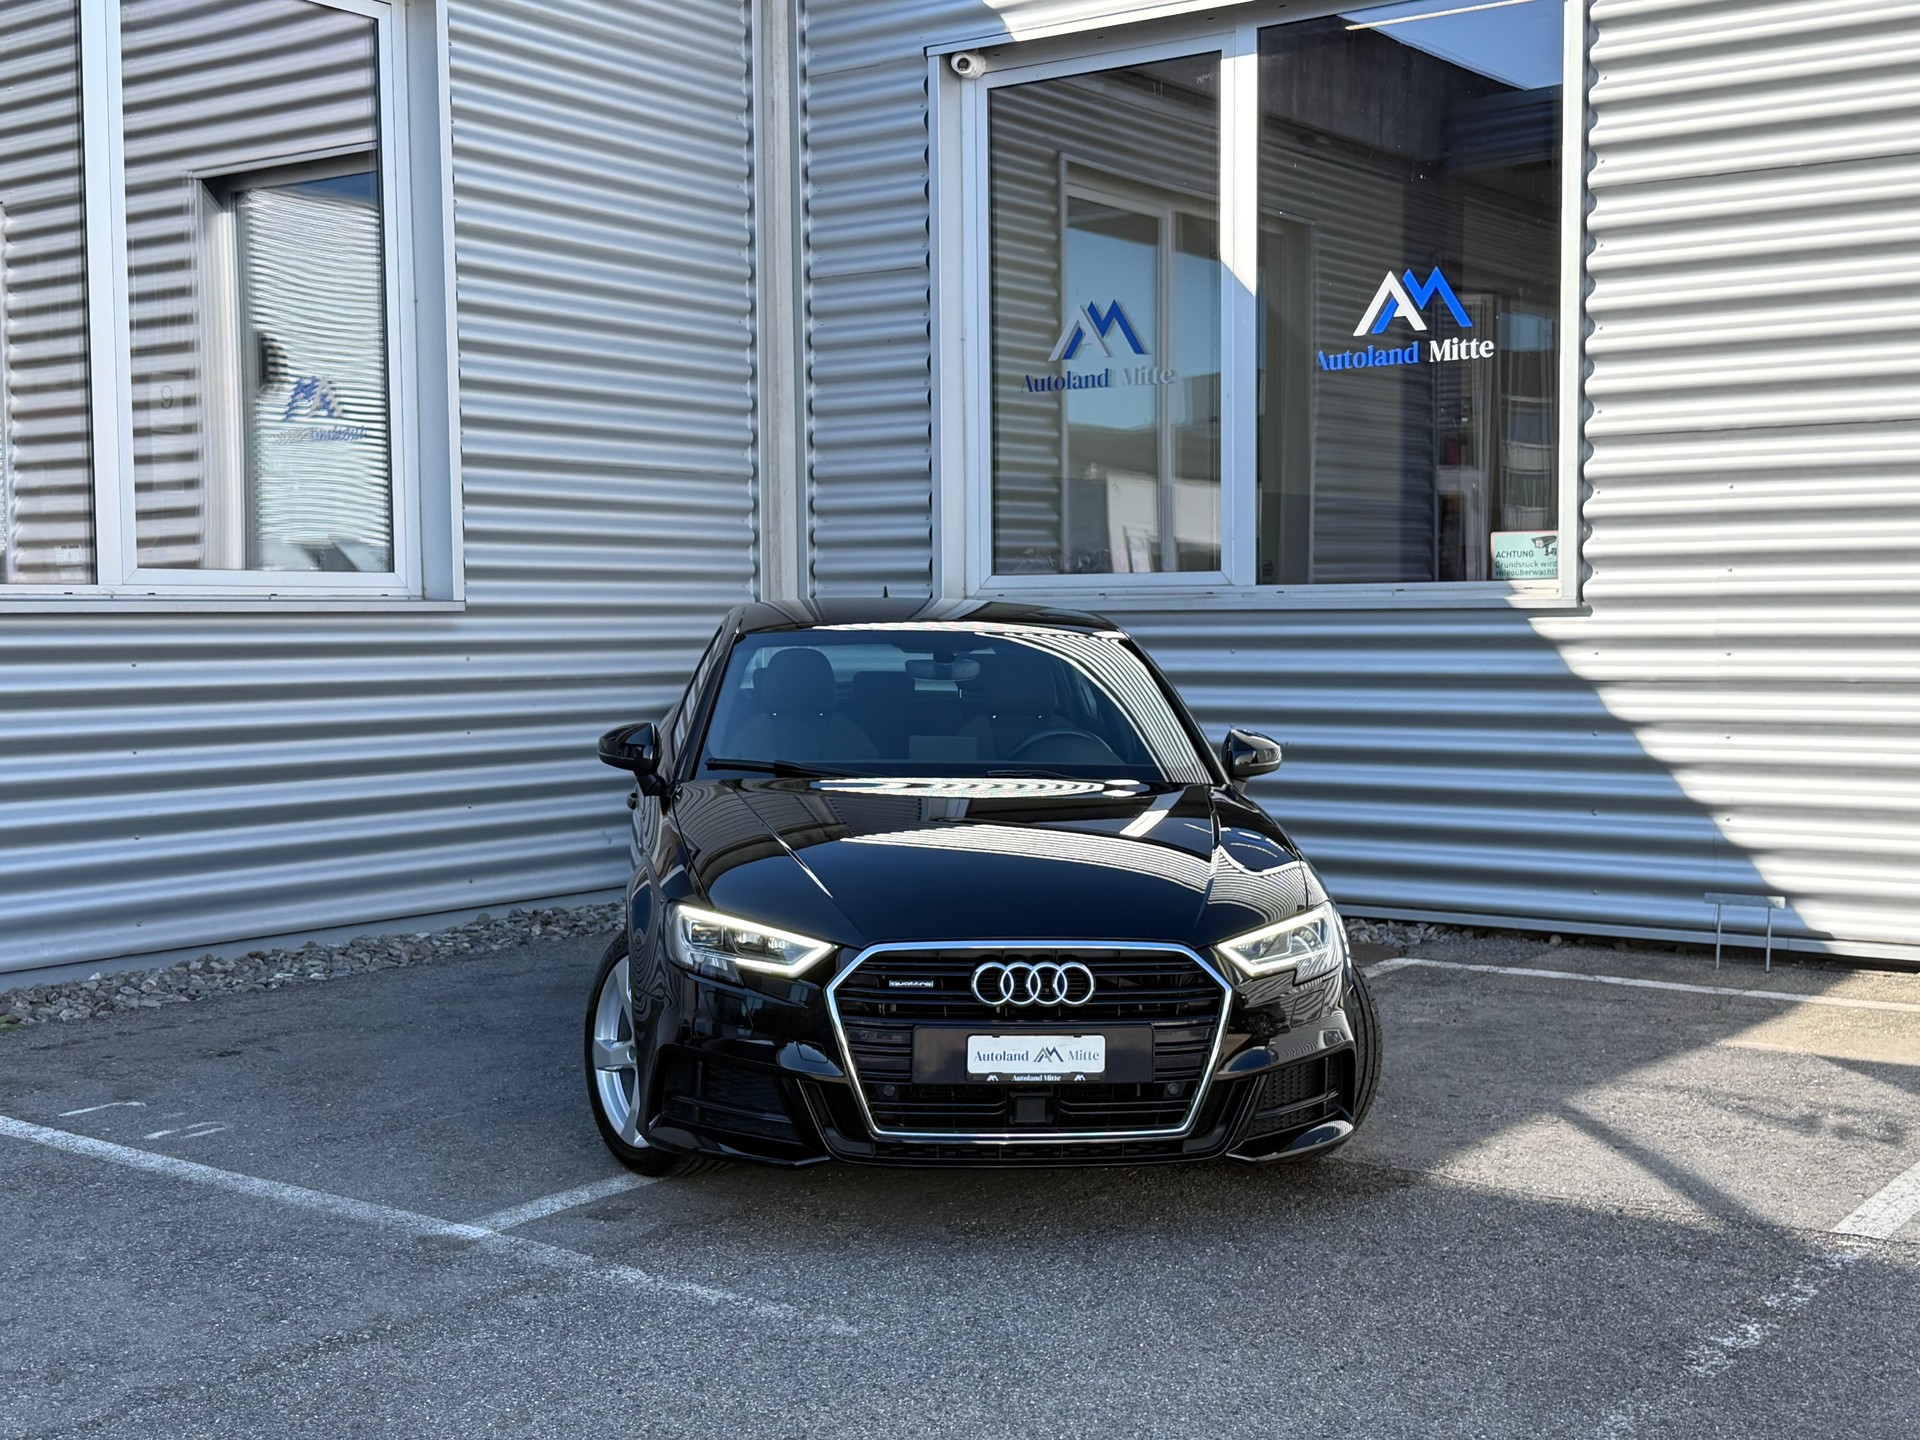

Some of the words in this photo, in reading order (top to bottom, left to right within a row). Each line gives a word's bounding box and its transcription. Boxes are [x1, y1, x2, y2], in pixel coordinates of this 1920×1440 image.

[1315, 340, 1419, 371] Autoland
[1429, 336, 1495, 363] Mitte
[1020, 367, 1110, 393] Autoland
[1496, 550, 1534, 558] ACHTUNG
[974, 1050, 1029, 1062] Autoland
[1068, 1050, 1100, 1061] Mitte
[1012, 1074, 1043, 1082] Autoland
[1043, 1074, 1062, 1082] Mitte
